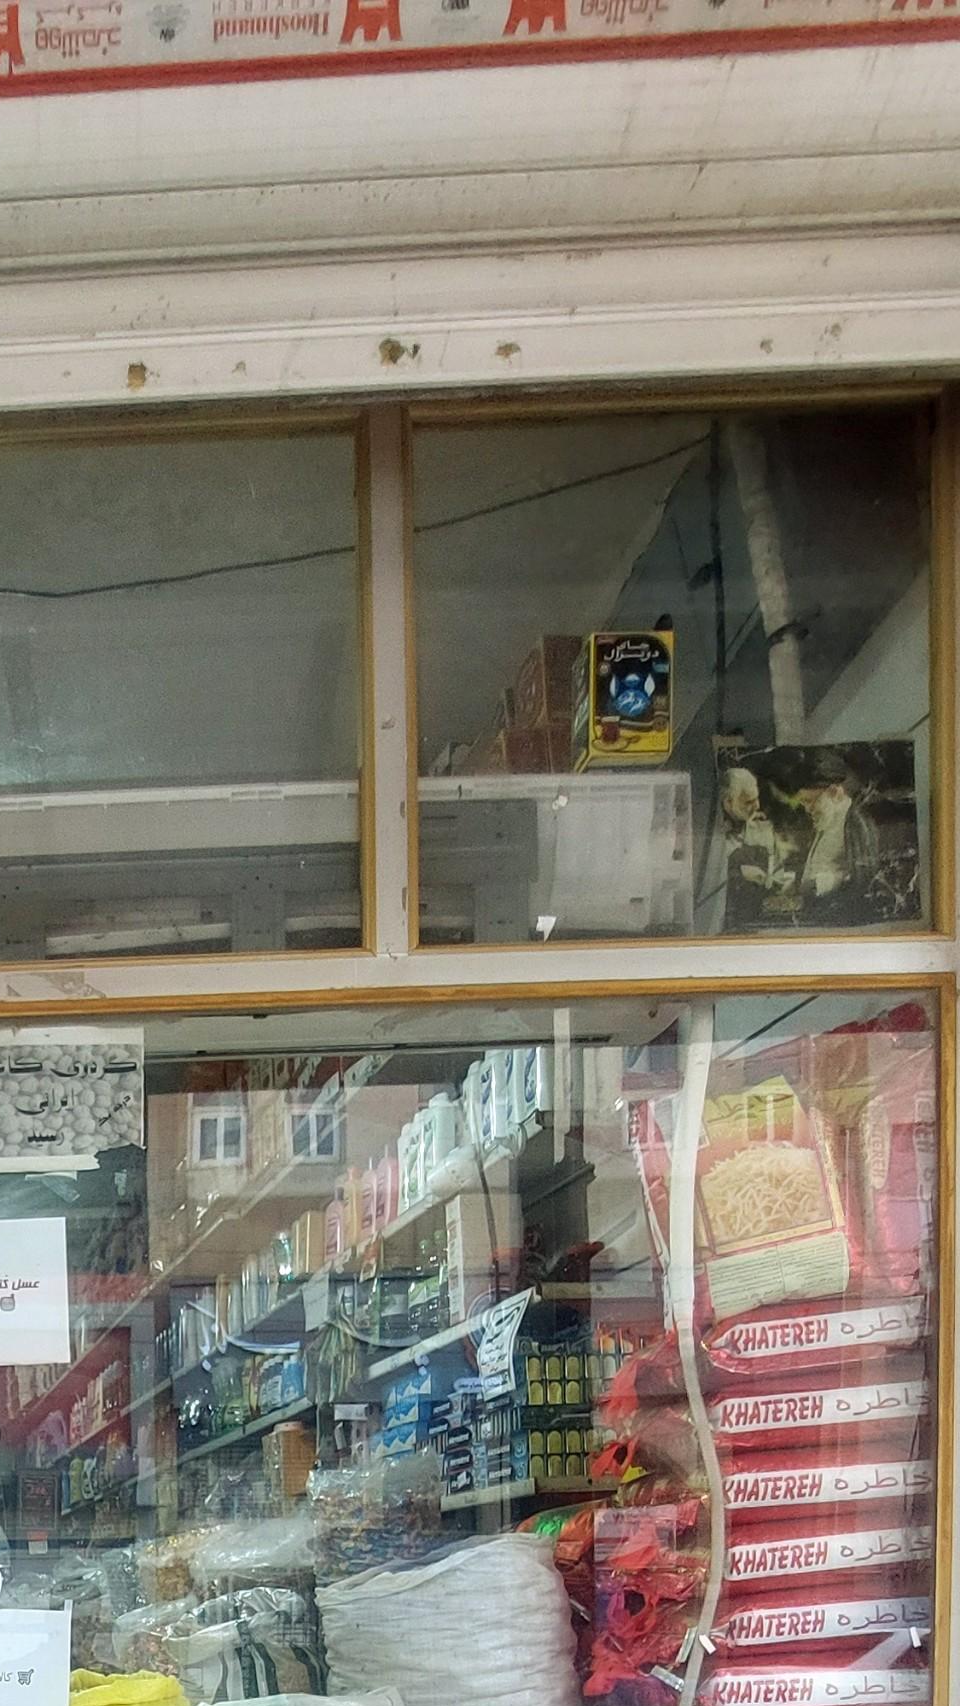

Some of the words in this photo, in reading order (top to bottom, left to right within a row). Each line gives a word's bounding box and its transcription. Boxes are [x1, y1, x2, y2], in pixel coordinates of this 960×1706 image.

[212, 12, 331, 43] Hooshmand
[26, 1126, 65, 1148] رسید
[11, 1277, 41, 1292] عسل
[728, 1318, 829, 1355] KHATEREH
[719, 1394, 824, 1429] KHATEREH
[723, 1472, 823, 1503] KHATEREH
[729, 1540, 829, 1577] KHATEREH
[724, 1608, 826, 1641] KHATEREH
[836, 1603, 930, 1631] خاطره
[711, 1677, 814, 1705] KHATEREH
[824, 1675, 921, 1701] خاطره
